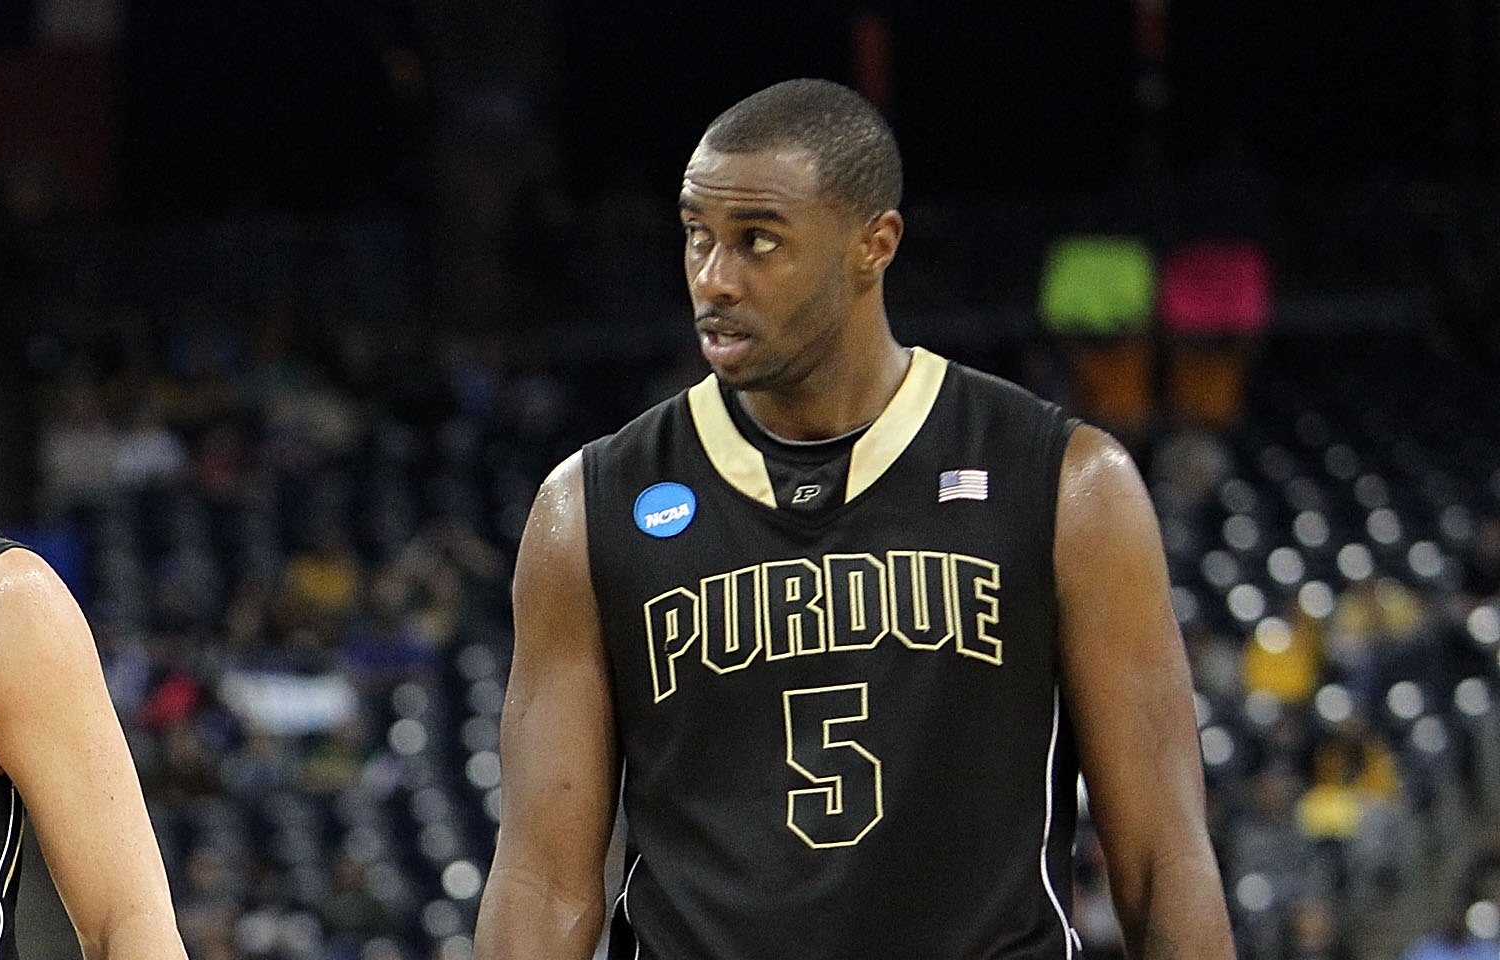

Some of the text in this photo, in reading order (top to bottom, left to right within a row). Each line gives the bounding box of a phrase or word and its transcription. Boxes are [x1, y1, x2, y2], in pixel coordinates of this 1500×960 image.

[644, 503, 691, 529] NCAA
[791, 484, 821, 504] P
[643, 550, 1003, 704] PURDUE
[783, 682, 884, 850] 5
